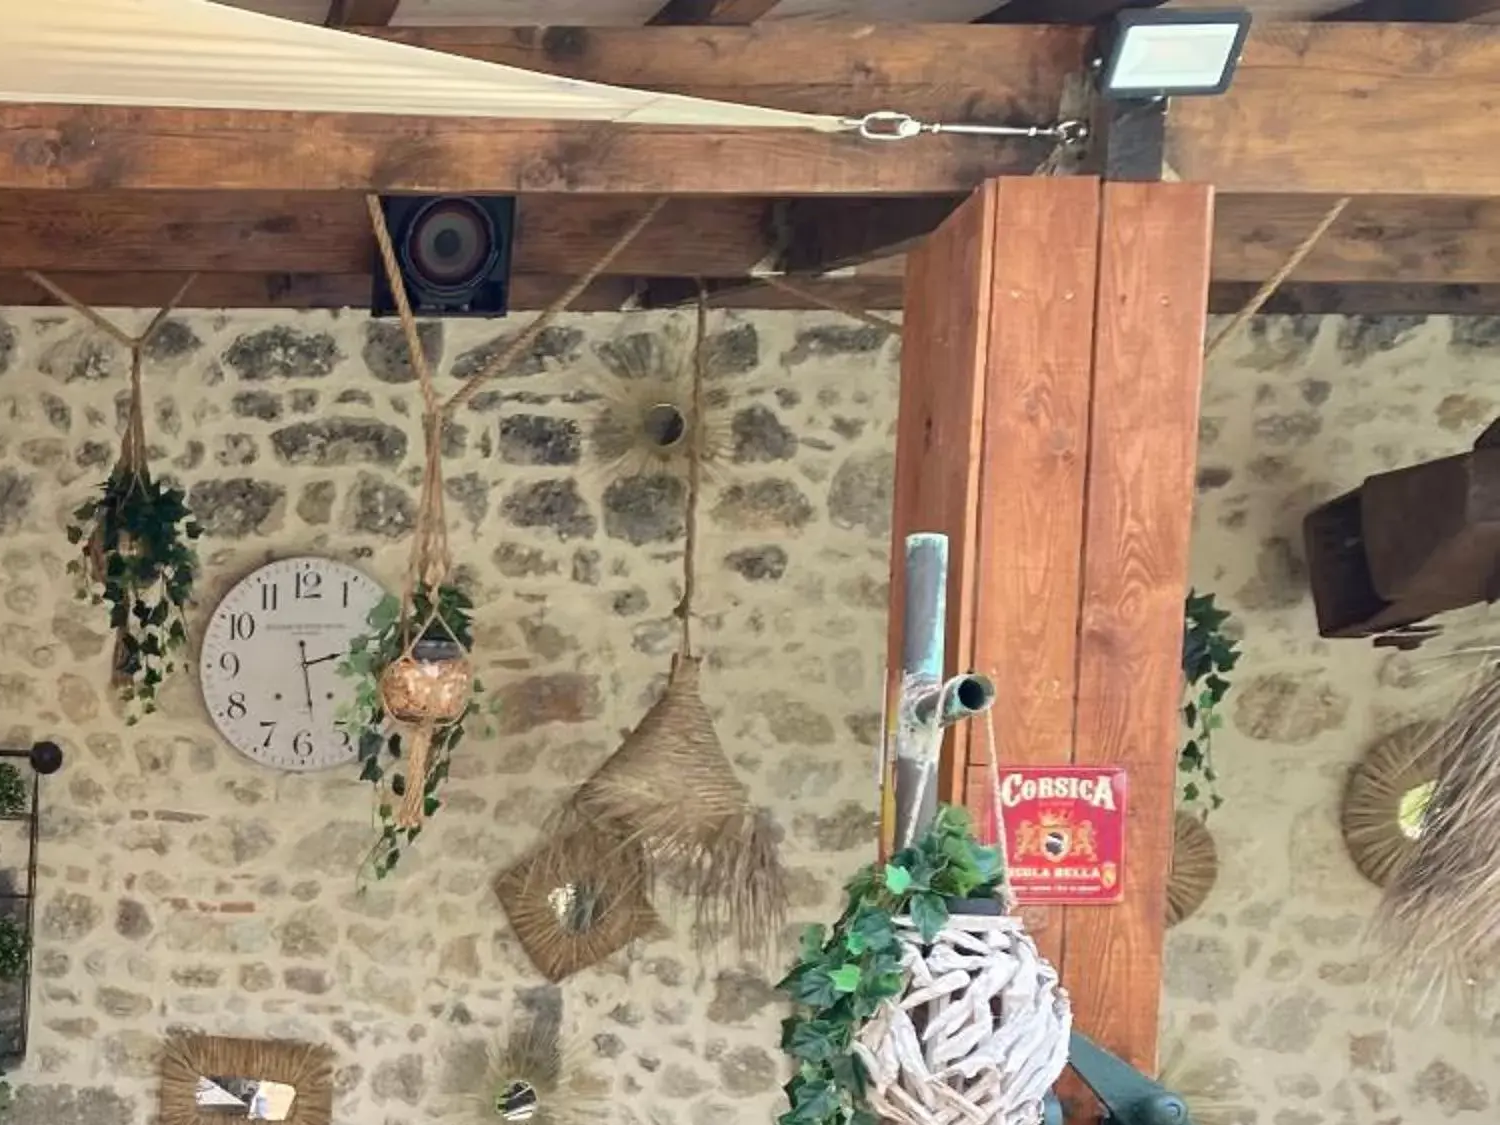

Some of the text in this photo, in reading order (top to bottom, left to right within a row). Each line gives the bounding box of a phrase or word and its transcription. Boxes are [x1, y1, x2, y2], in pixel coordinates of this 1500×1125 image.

[262, 584, 278, 611] 11
[295, 571, 323, 599] 12
[342, 581, 349, 608] 1
[230, 613, 255, 640] 10
[219, 652, 240, 680] 9
[227, 691, 247, 719] 8
[259, 721, 277, 747] 7
[293, 729, 313, 757] 6
[333, 720, 350, 746] 5
[1002, 773, 1117, 811] CORSICA
